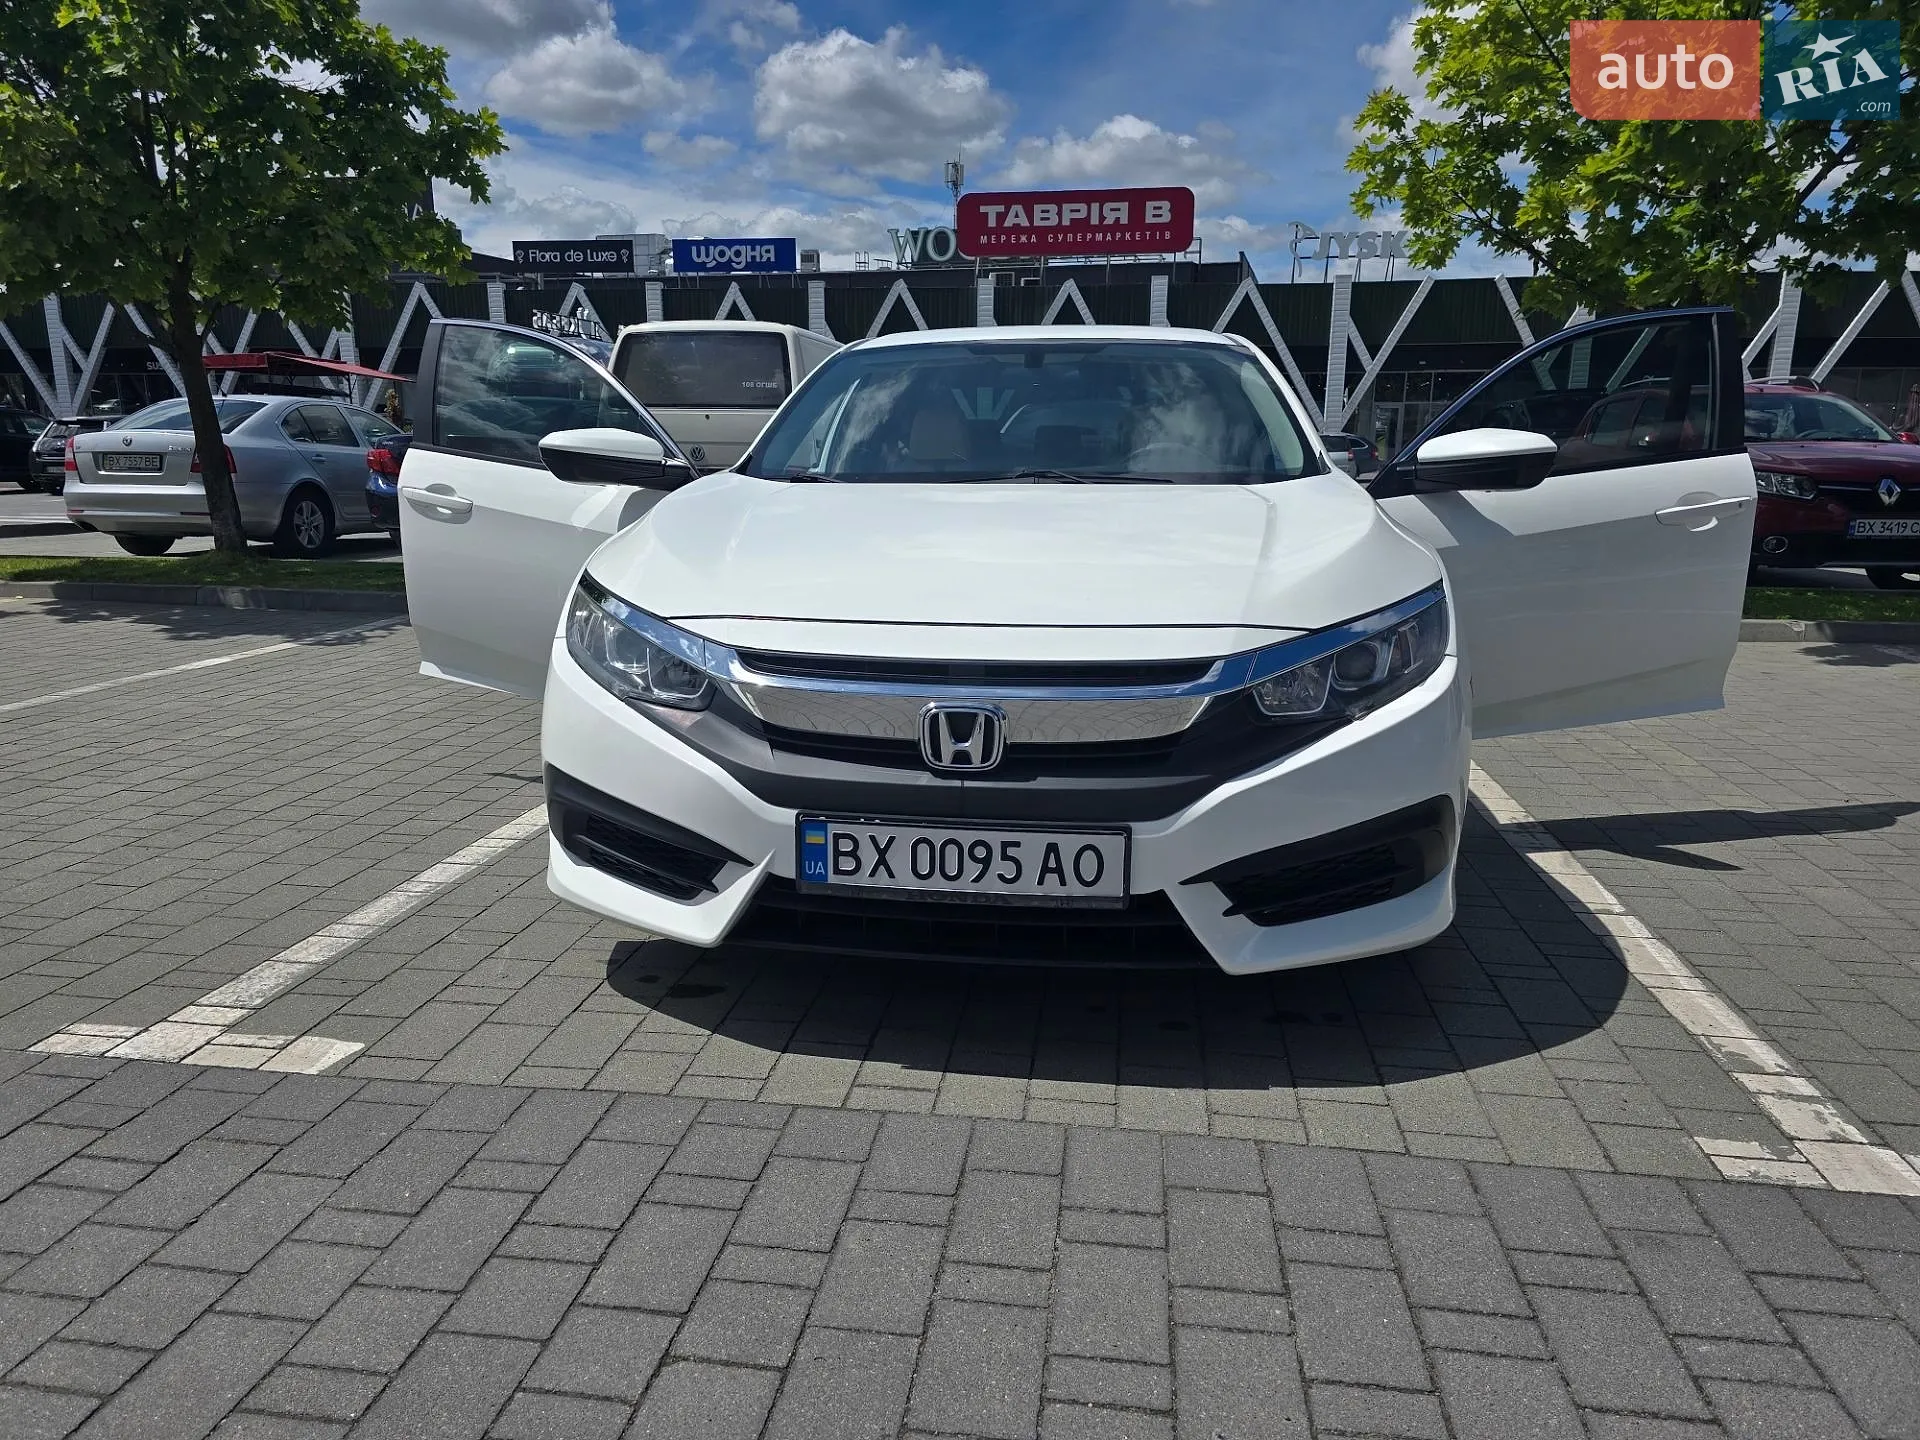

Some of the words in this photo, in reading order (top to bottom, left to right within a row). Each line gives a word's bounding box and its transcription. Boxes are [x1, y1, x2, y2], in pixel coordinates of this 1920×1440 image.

[979, 201, 1129, 228] ТАВРІЯ
[1144, 200, 1172, 224] В
[887, 226, 975, 264] WO
[980, 233, 1037, 245] МЕРЕЖА
[1047, 230, 1172, 244] СУПЕРМАРКЕТІВ
[1311, 230, 1410, 261] JYSK
[528, 249, 560, 263] Flora
[564, 249, 584, 263] de
[587, 249, 617, 262] Luxe
[1878, 521, 1908, 534] 3419
[1910, 521, 1920, 534] C
[805, 860, 825, 875] UA
[909, 836, 1023, 885] 0095
